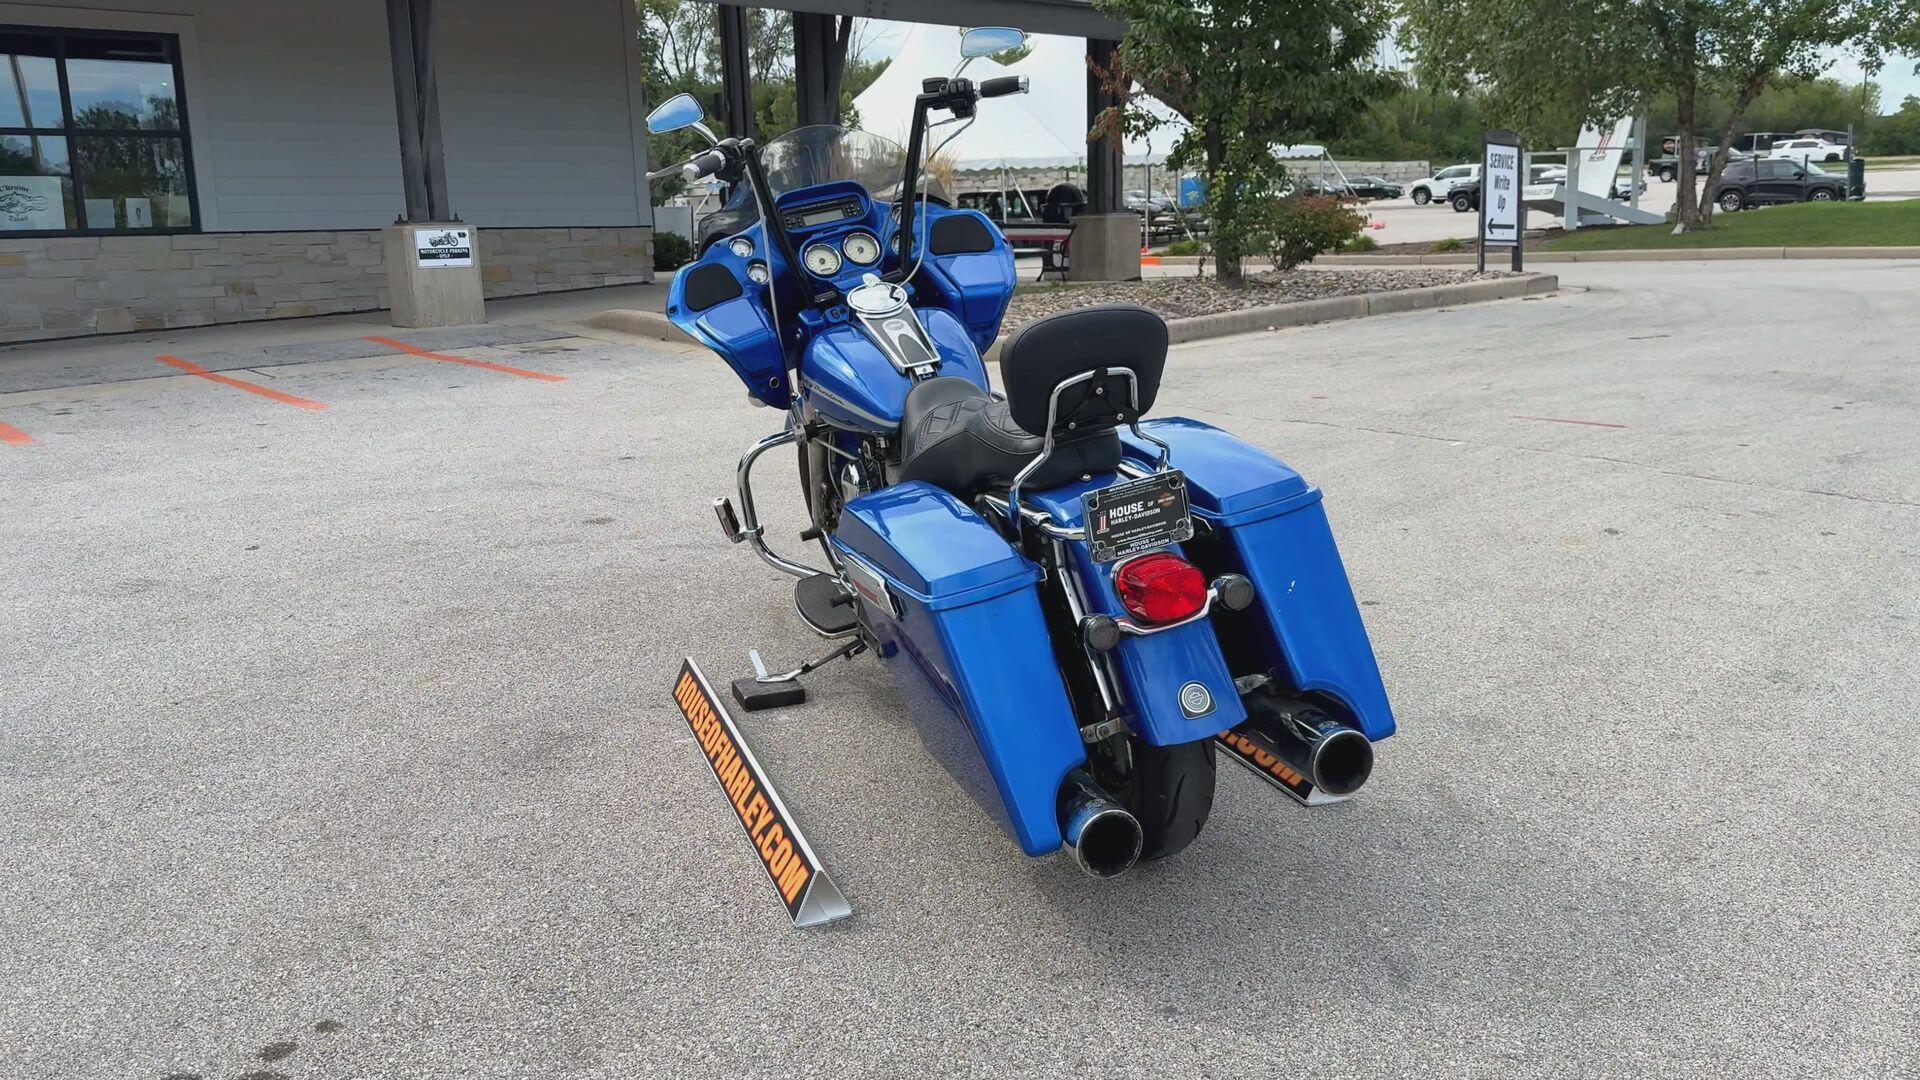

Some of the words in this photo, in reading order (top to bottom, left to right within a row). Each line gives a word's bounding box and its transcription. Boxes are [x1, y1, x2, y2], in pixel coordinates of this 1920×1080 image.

[1489, 153, 1514, 170] SERVICE
[1494, 174, 1510, 190] Write
[1497, 194, 1506, 213] Up
[1109, 501, 1145, 520] HOUSE
[1147, 500, 1155, 508] OF
[1110, 507, 1161, 526] HARLEY-DAVIDSON
[1117, 537, 1170, 557] HARLEY-DAVIDSON
[1129, 538, 1150, 548] HOUSE
[674, 671, 810, 905] HOUSEOFHARLEY.COM
